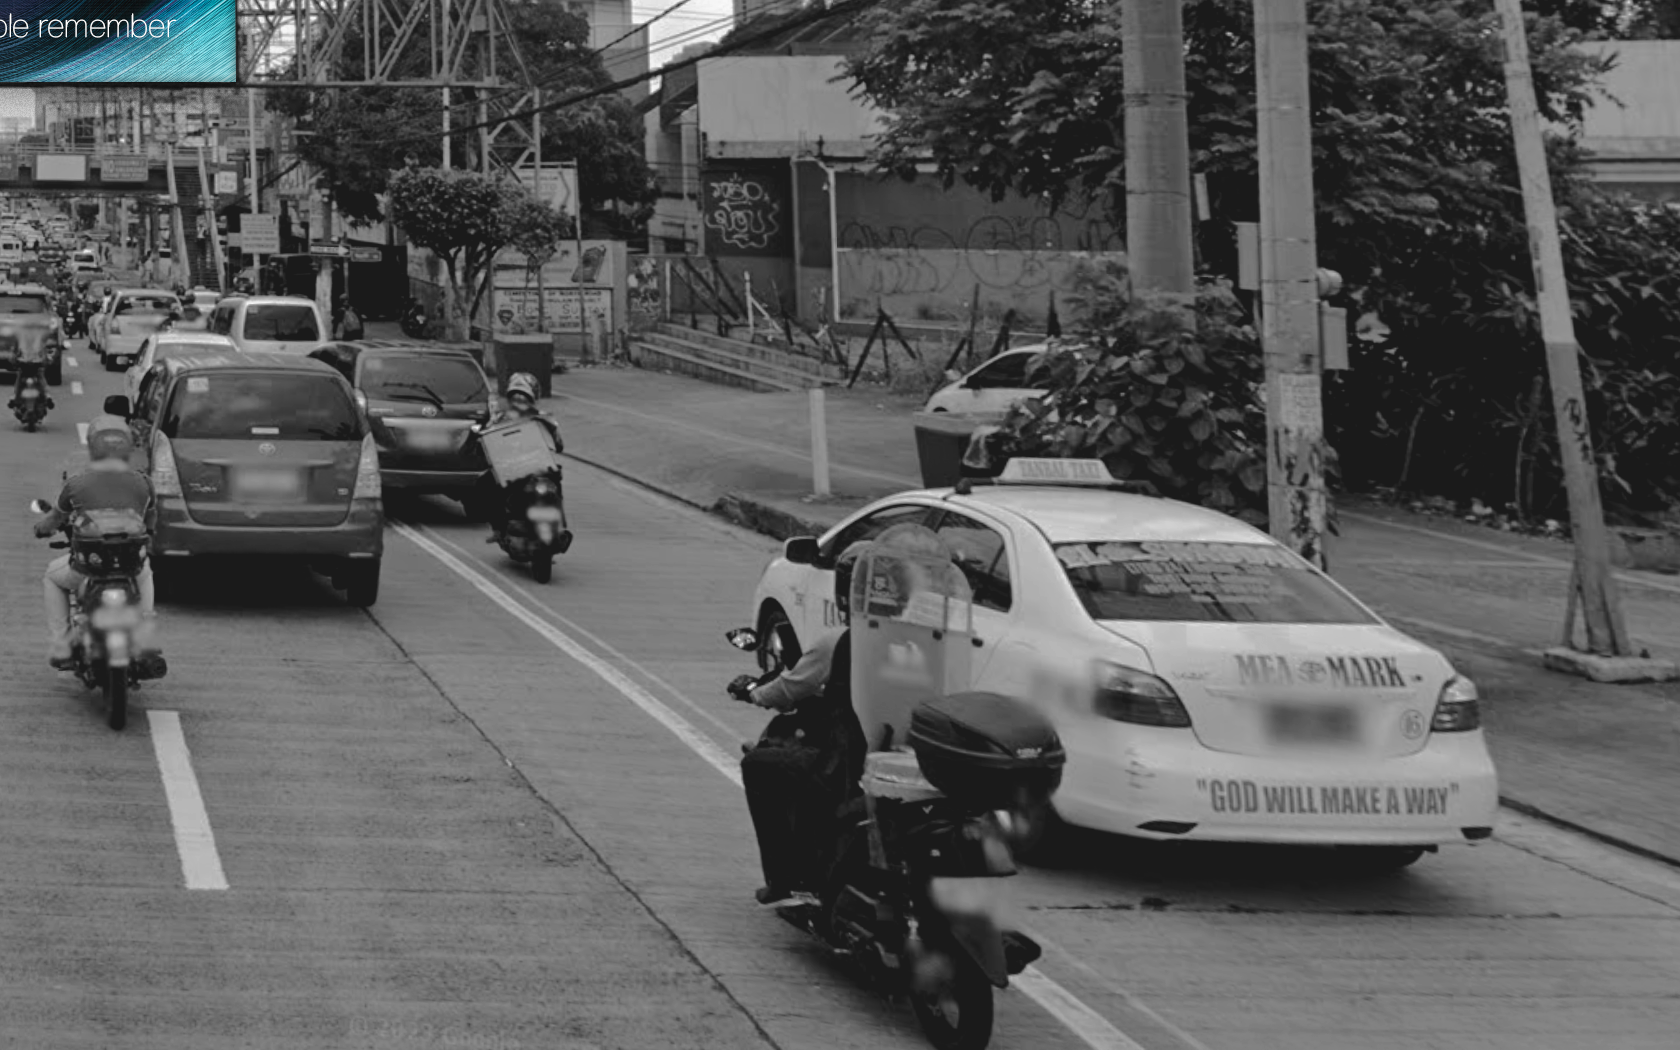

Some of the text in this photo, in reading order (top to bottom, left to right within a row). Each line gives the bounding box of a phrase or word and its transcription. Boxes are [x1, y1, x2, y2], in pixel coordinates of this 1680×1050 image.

[38, 12, 177, 39] remember
[1069, 461, 1101, 479] TAXI
[1325, 656, 1407, 688] MARK
[1196, 779, 1460, 816] "GOD WILL MAKE A WAY"
